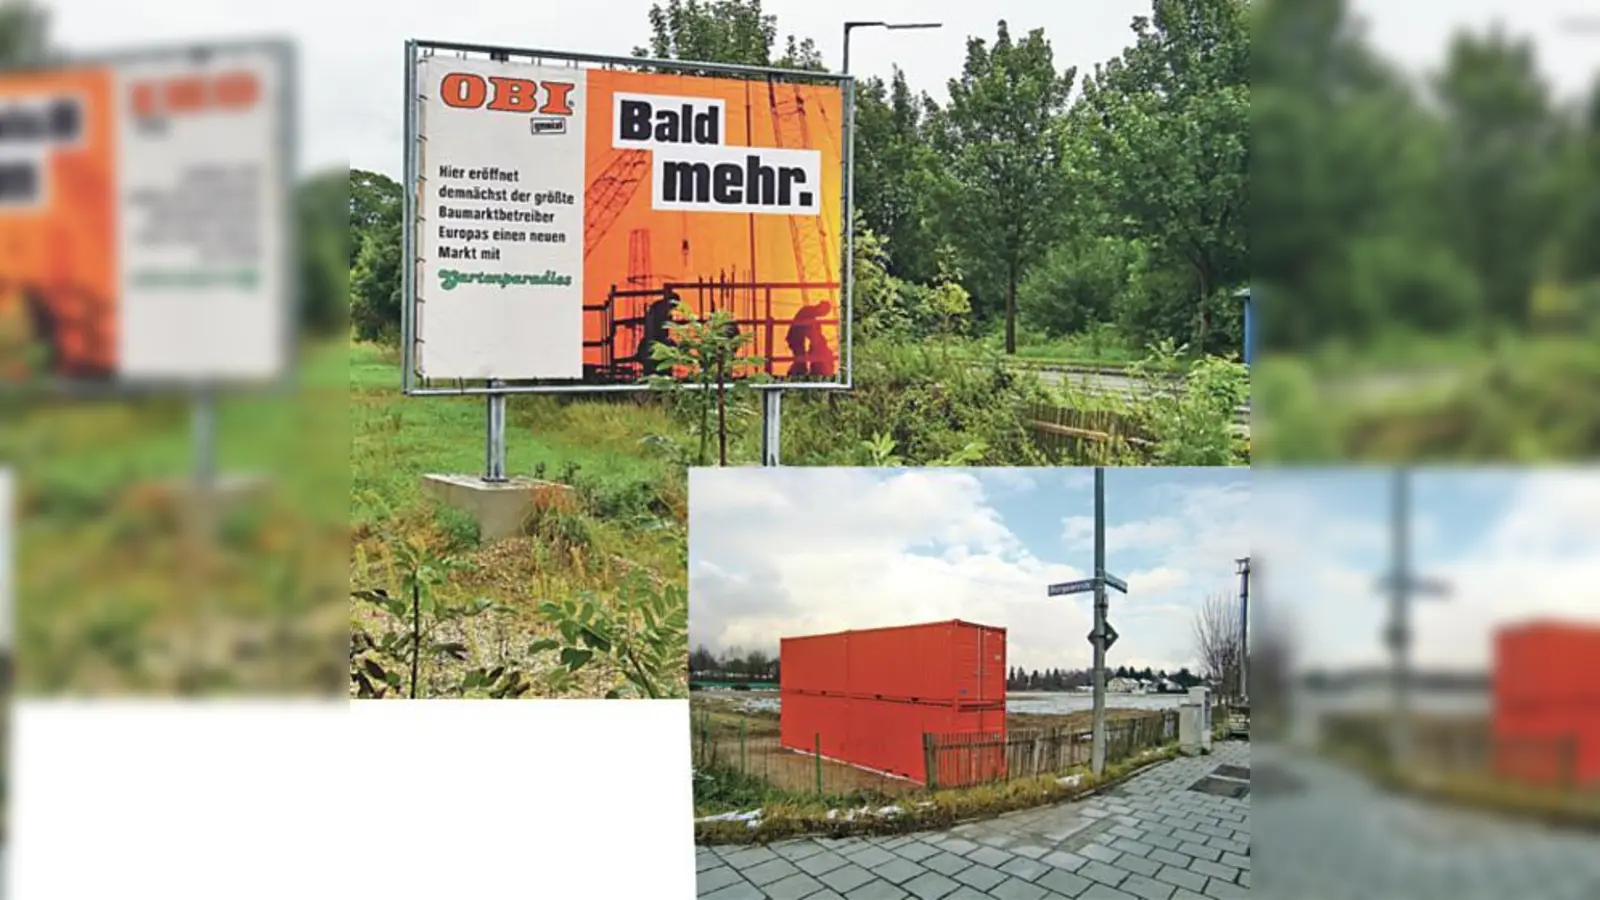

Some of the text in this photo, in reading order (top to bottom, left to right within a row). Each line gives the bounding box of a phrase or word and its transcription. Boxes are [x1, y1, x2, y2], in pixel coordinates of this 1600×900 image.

[440, 72, 575, 116] OBI
[619, 99, 720, 146] Bald
[438, 165, 520, 182] Hier eröffnet
[662, 155, 813, 207] mehr.
[438, 184, 575, 206] demnächst der größte
[439, 205, 555, 223] Baumarktbetreiber
[439, 225, 566, 243] Europas einen neuen
[438, 245, 501, 260] Markt mit
